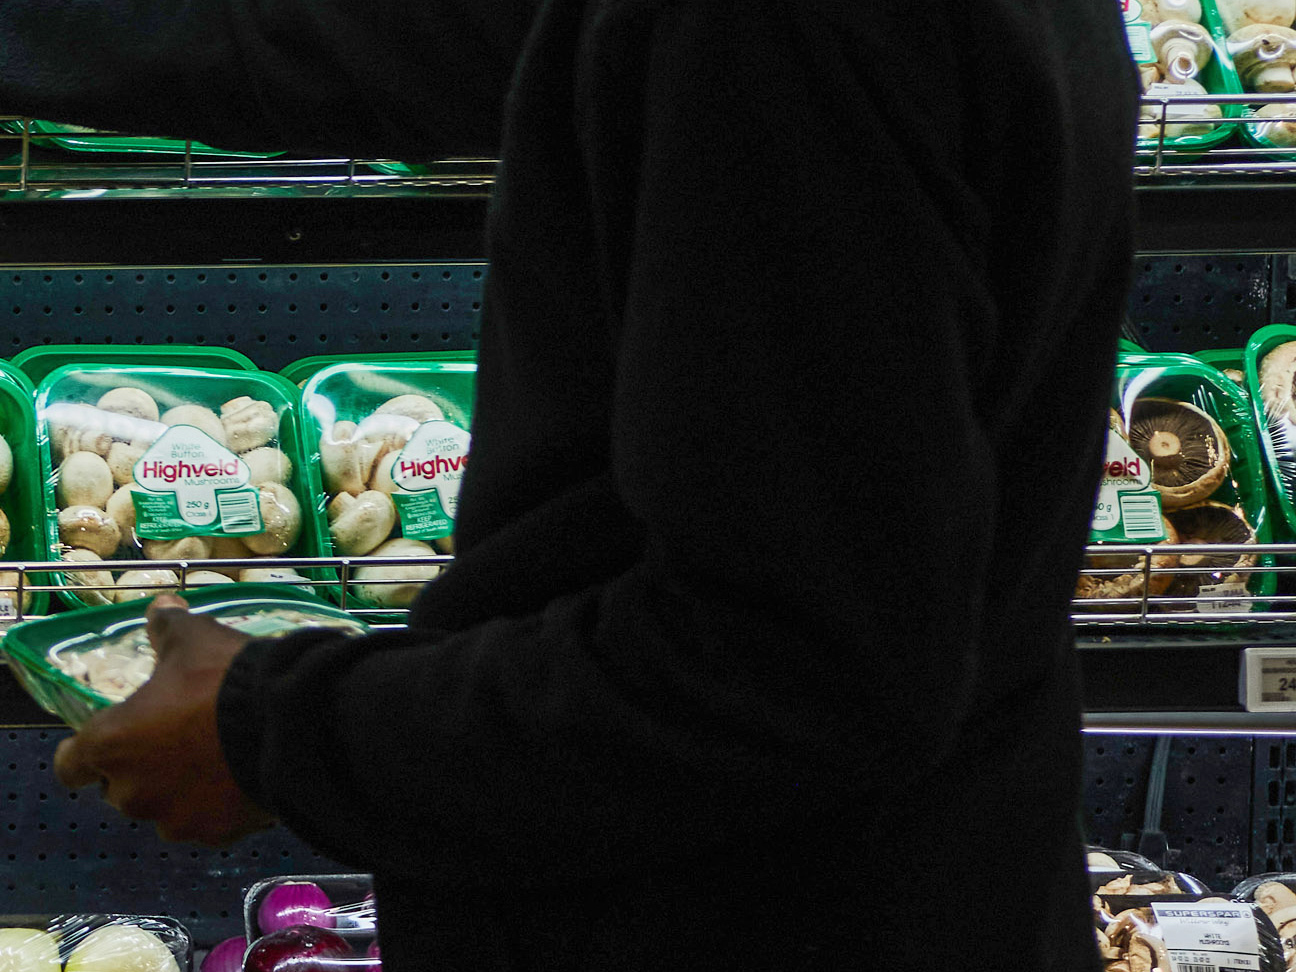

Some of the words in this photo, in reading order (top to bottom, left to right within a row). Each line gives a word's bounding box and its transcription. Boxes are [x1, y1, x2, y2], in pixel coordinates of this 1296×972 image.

[143, 459, 238, 483] Highveld
[184, 477, 239, 486] Mushrooms
[1165, 910, 1241, 918] SUPERSPAR
